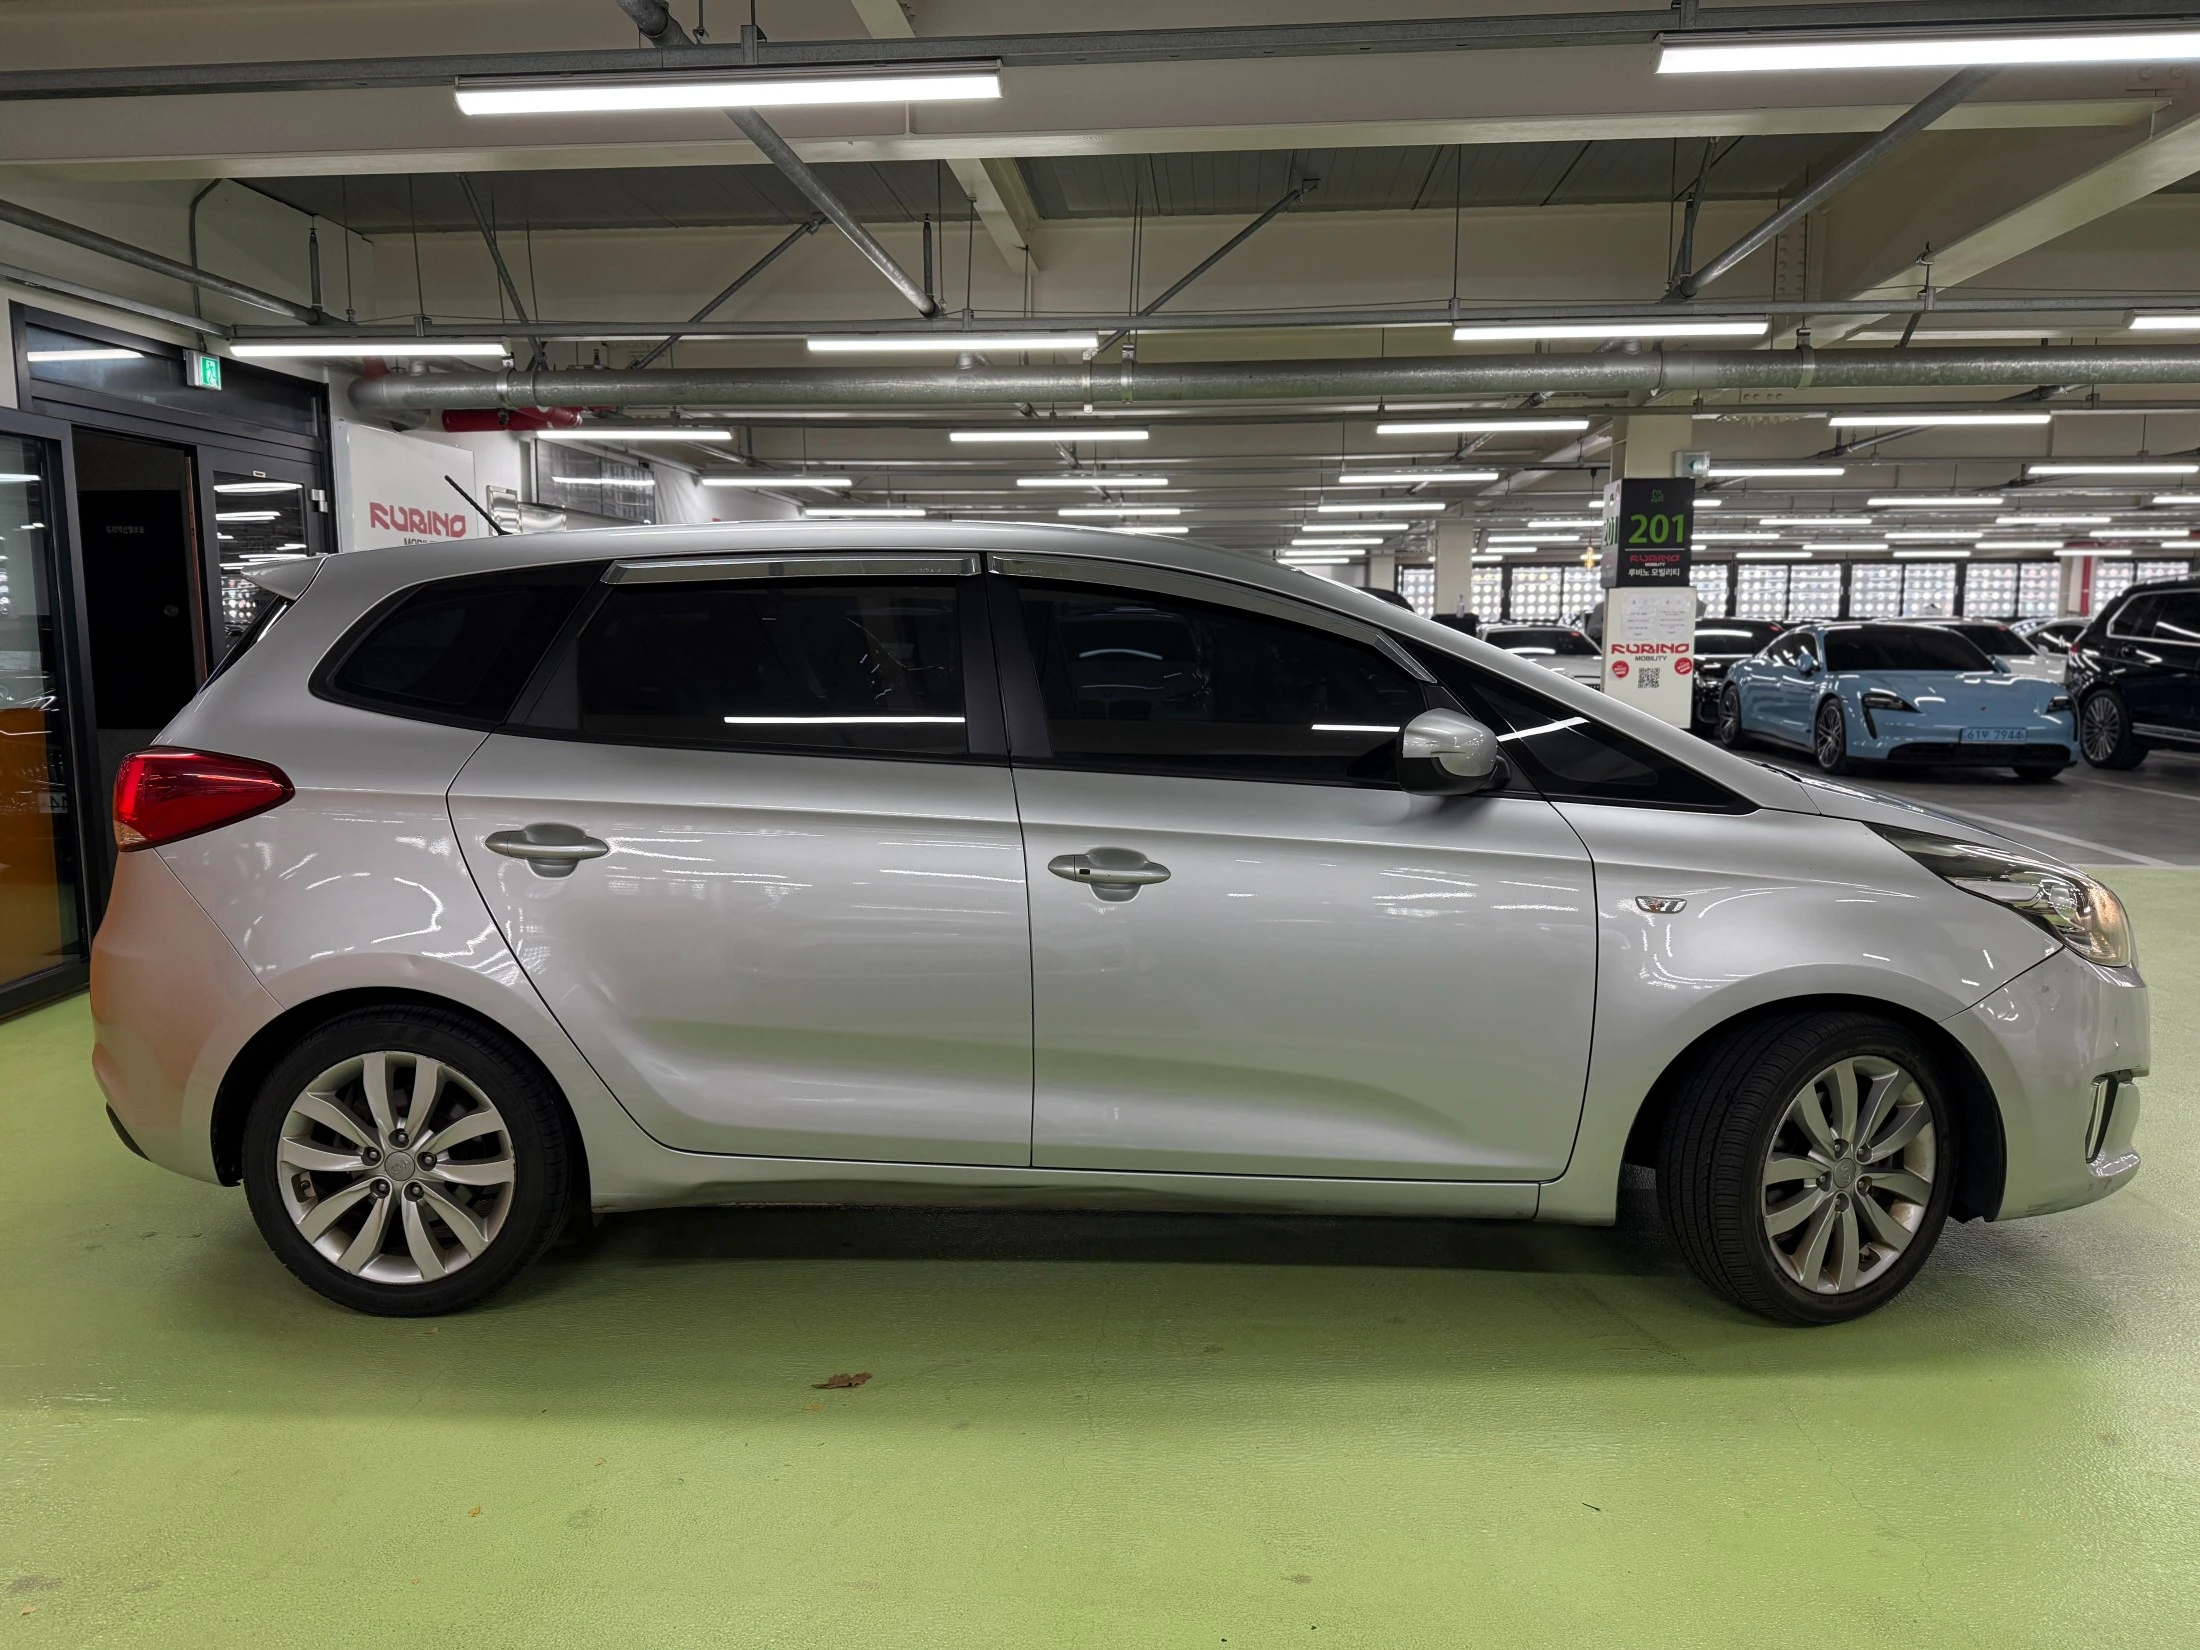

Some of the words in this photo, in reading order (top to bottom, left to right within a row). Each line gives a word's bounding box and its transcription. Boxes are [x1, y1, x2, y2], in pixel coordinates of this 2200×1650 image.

[369, 502, 467, 538] RUBINO
[1628, 514, 1685, 544] 201
[1604, 516, 1619, 546] 201
[1629, 554, 1680, 563] RUBINO
[1628, 568, 1650, 577] 루비노
[1651, 568, 1680, 577] 모빌리티
[1611, 643, 1690, 655] RUBINO
